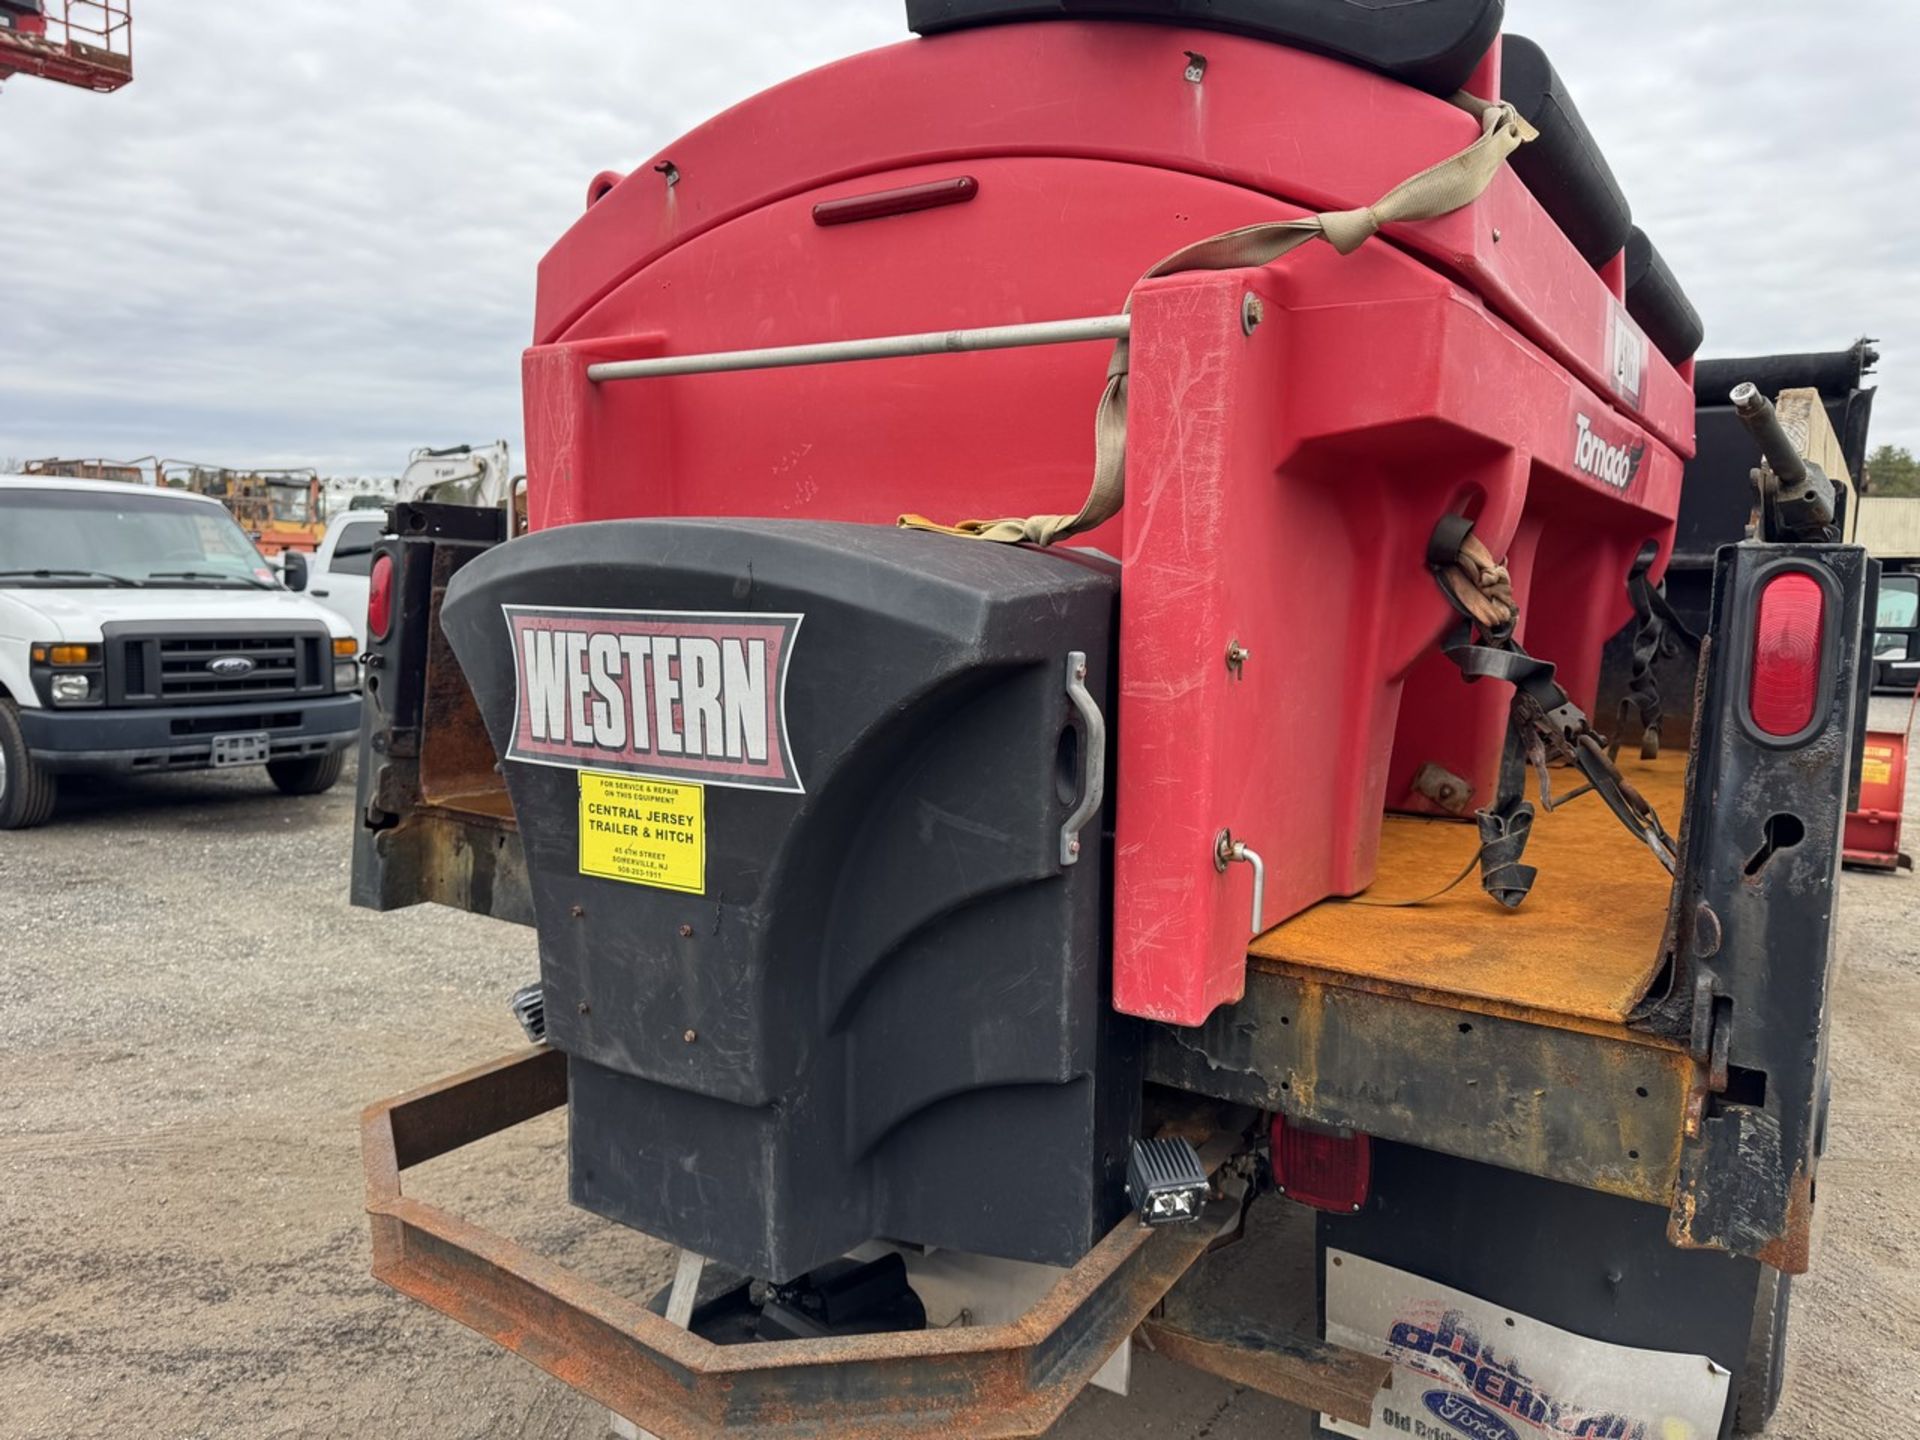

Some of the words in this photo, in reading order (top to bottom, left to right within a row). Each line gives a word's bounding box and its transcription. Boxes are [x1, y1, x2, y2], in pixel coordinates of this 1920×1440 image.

[1574, 412, 1631, 489] Tornado
[522, 629, 768, 765] WESTERN
[600, 780, 613, 788] FOR
[615, 782, 643, 792] SERVICE
[646, 784, 652, 793] &
[653, 785, 679, 795] REPAIR
[604, 789, 614, 797] ON
[616, 791, 632, 799] THIS
[633, 793, 675, 804] EQUIPMENT
[588, 803, 642, 820] CENTRAL
[646, 810, 694, 827] JERSEY
[589, 819, 638, 836] TRAILER
[642, 827, 651, 838] &
[655, 829, 694, 844] HITCH
[639, 850, 666, 860] STREET
[1382, 1407, 1411, 1432] Old
